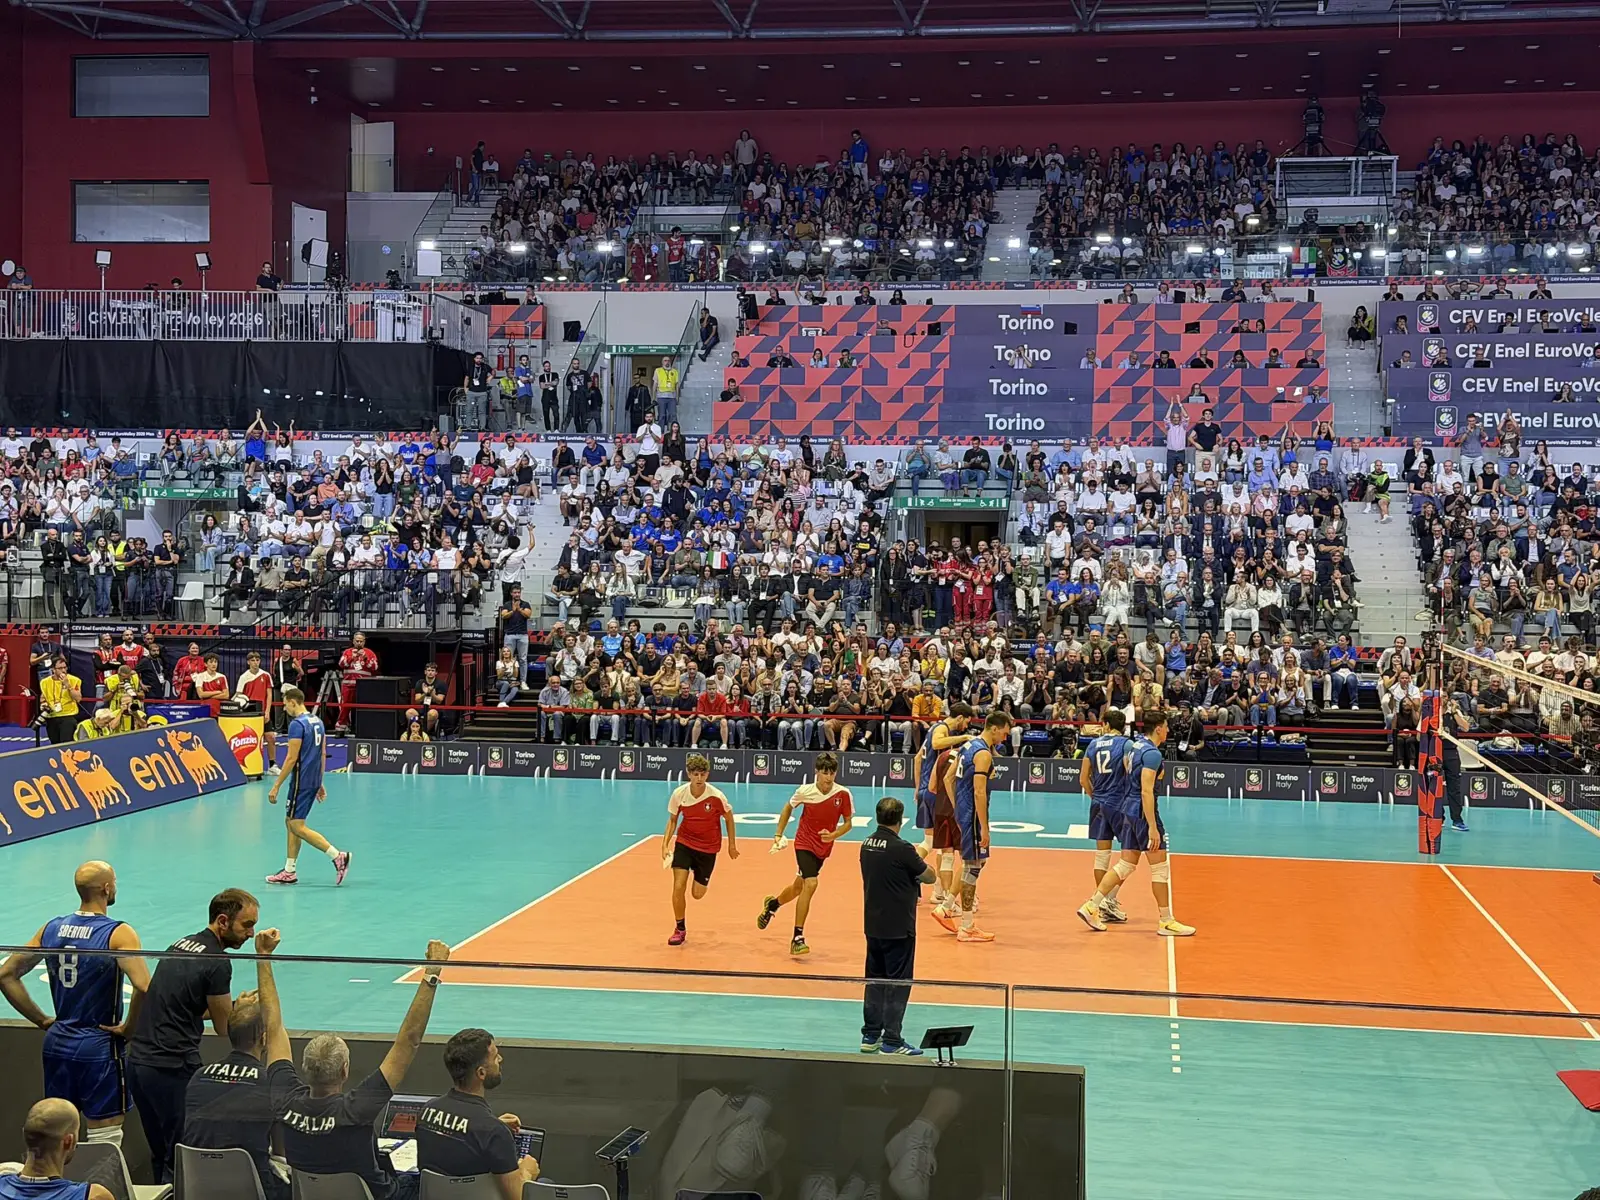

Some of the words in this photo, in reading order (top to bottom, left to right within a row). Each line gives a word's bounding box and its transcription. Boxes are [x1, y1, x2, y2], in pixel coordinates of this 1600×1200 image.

[998, 314, 1054, 330] Torino
[1449, 309, 1484, 324] CEV
[993, 344, 1051, 361] Torino
[1455, 343, 1491, 358] CEV
[1494, 342, 1530, 358] Enel
[989, 378, 1047, 395] Torino
[1462, 378, 1499, 392] CEV
[1502, 377, 1539, 392] Enel
[985, 412, 1045, 431] Torino
[230, 735, 257, 751] Fonzies
[314, 725, 322, 746] 6
[448, 757, 463, 765] Italy
[515, 751, 535, 759] Torino
[1096, 750, 1113, 774] 12
[129, 737, 185, 791] eni
[580, 760, 595, 768] Italy
[849, 760, 870, 768] Torino
[849, 767, 864, 775] Italy
[1058, 766, 1080, 774] Torino
[1203, 771, 1225, 779] Torino
[1203, 778, 1218, 786] Italy
[1276, 773, 1298, 781] Torino
[1351, 775, 1374, 783] Torino
[13, 757, 80, 818] eni
[1276, 781, 1291, 789] Italy
[1351, 782, 1367, 791] Italy
[1502, 789, 1518, 797] Italy
[58, 924, 94, 940] SBERTOLI
[58, 945, 78, 988] 8
[204, 1063, 259, 1079] ITALIA
[283, 1110, 336, 1131] ITALIA
[421, 1107, 469, 1134] ITALIA
